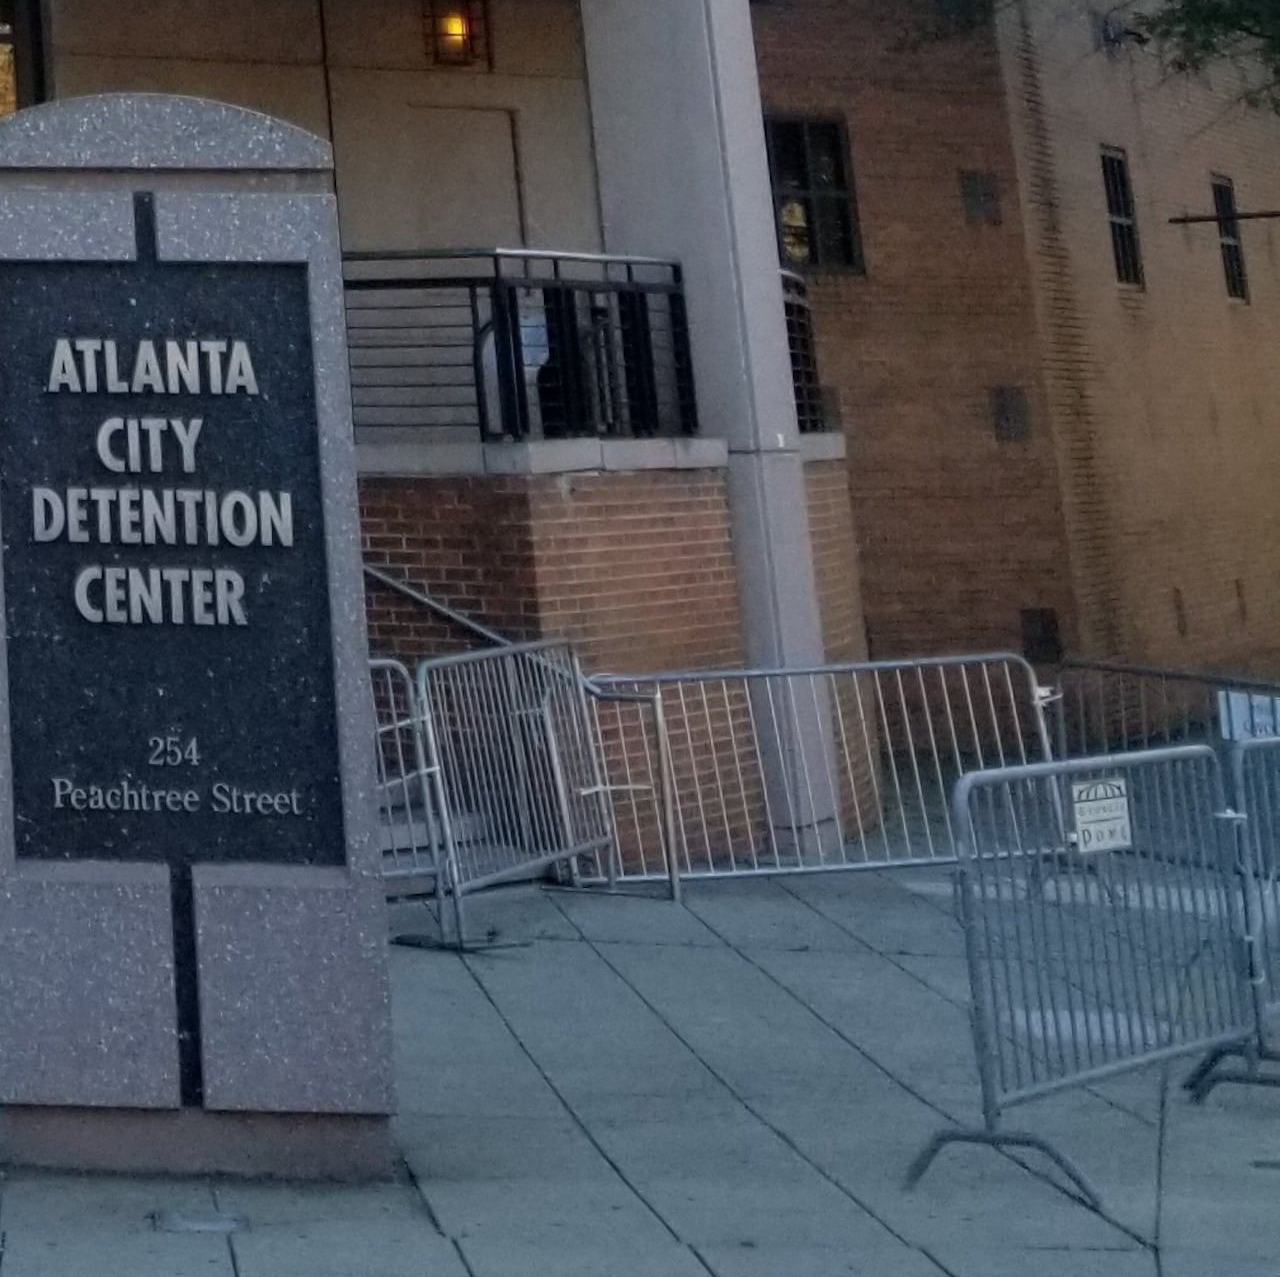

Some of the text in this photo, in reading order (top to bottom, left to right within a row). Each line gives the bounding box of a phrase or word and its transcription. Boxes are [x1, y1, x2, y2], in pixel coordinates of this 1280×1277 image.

[47, 339, 260, 395] ATLANTA
[96, 417, 204, 473] CITY
[32, 487, 294, 547] DETENTION
[73, 565, 249, 625] CENTER
[148, 736, 201, 766] 254
[51, 777, 305, 815] Peachtree Street
